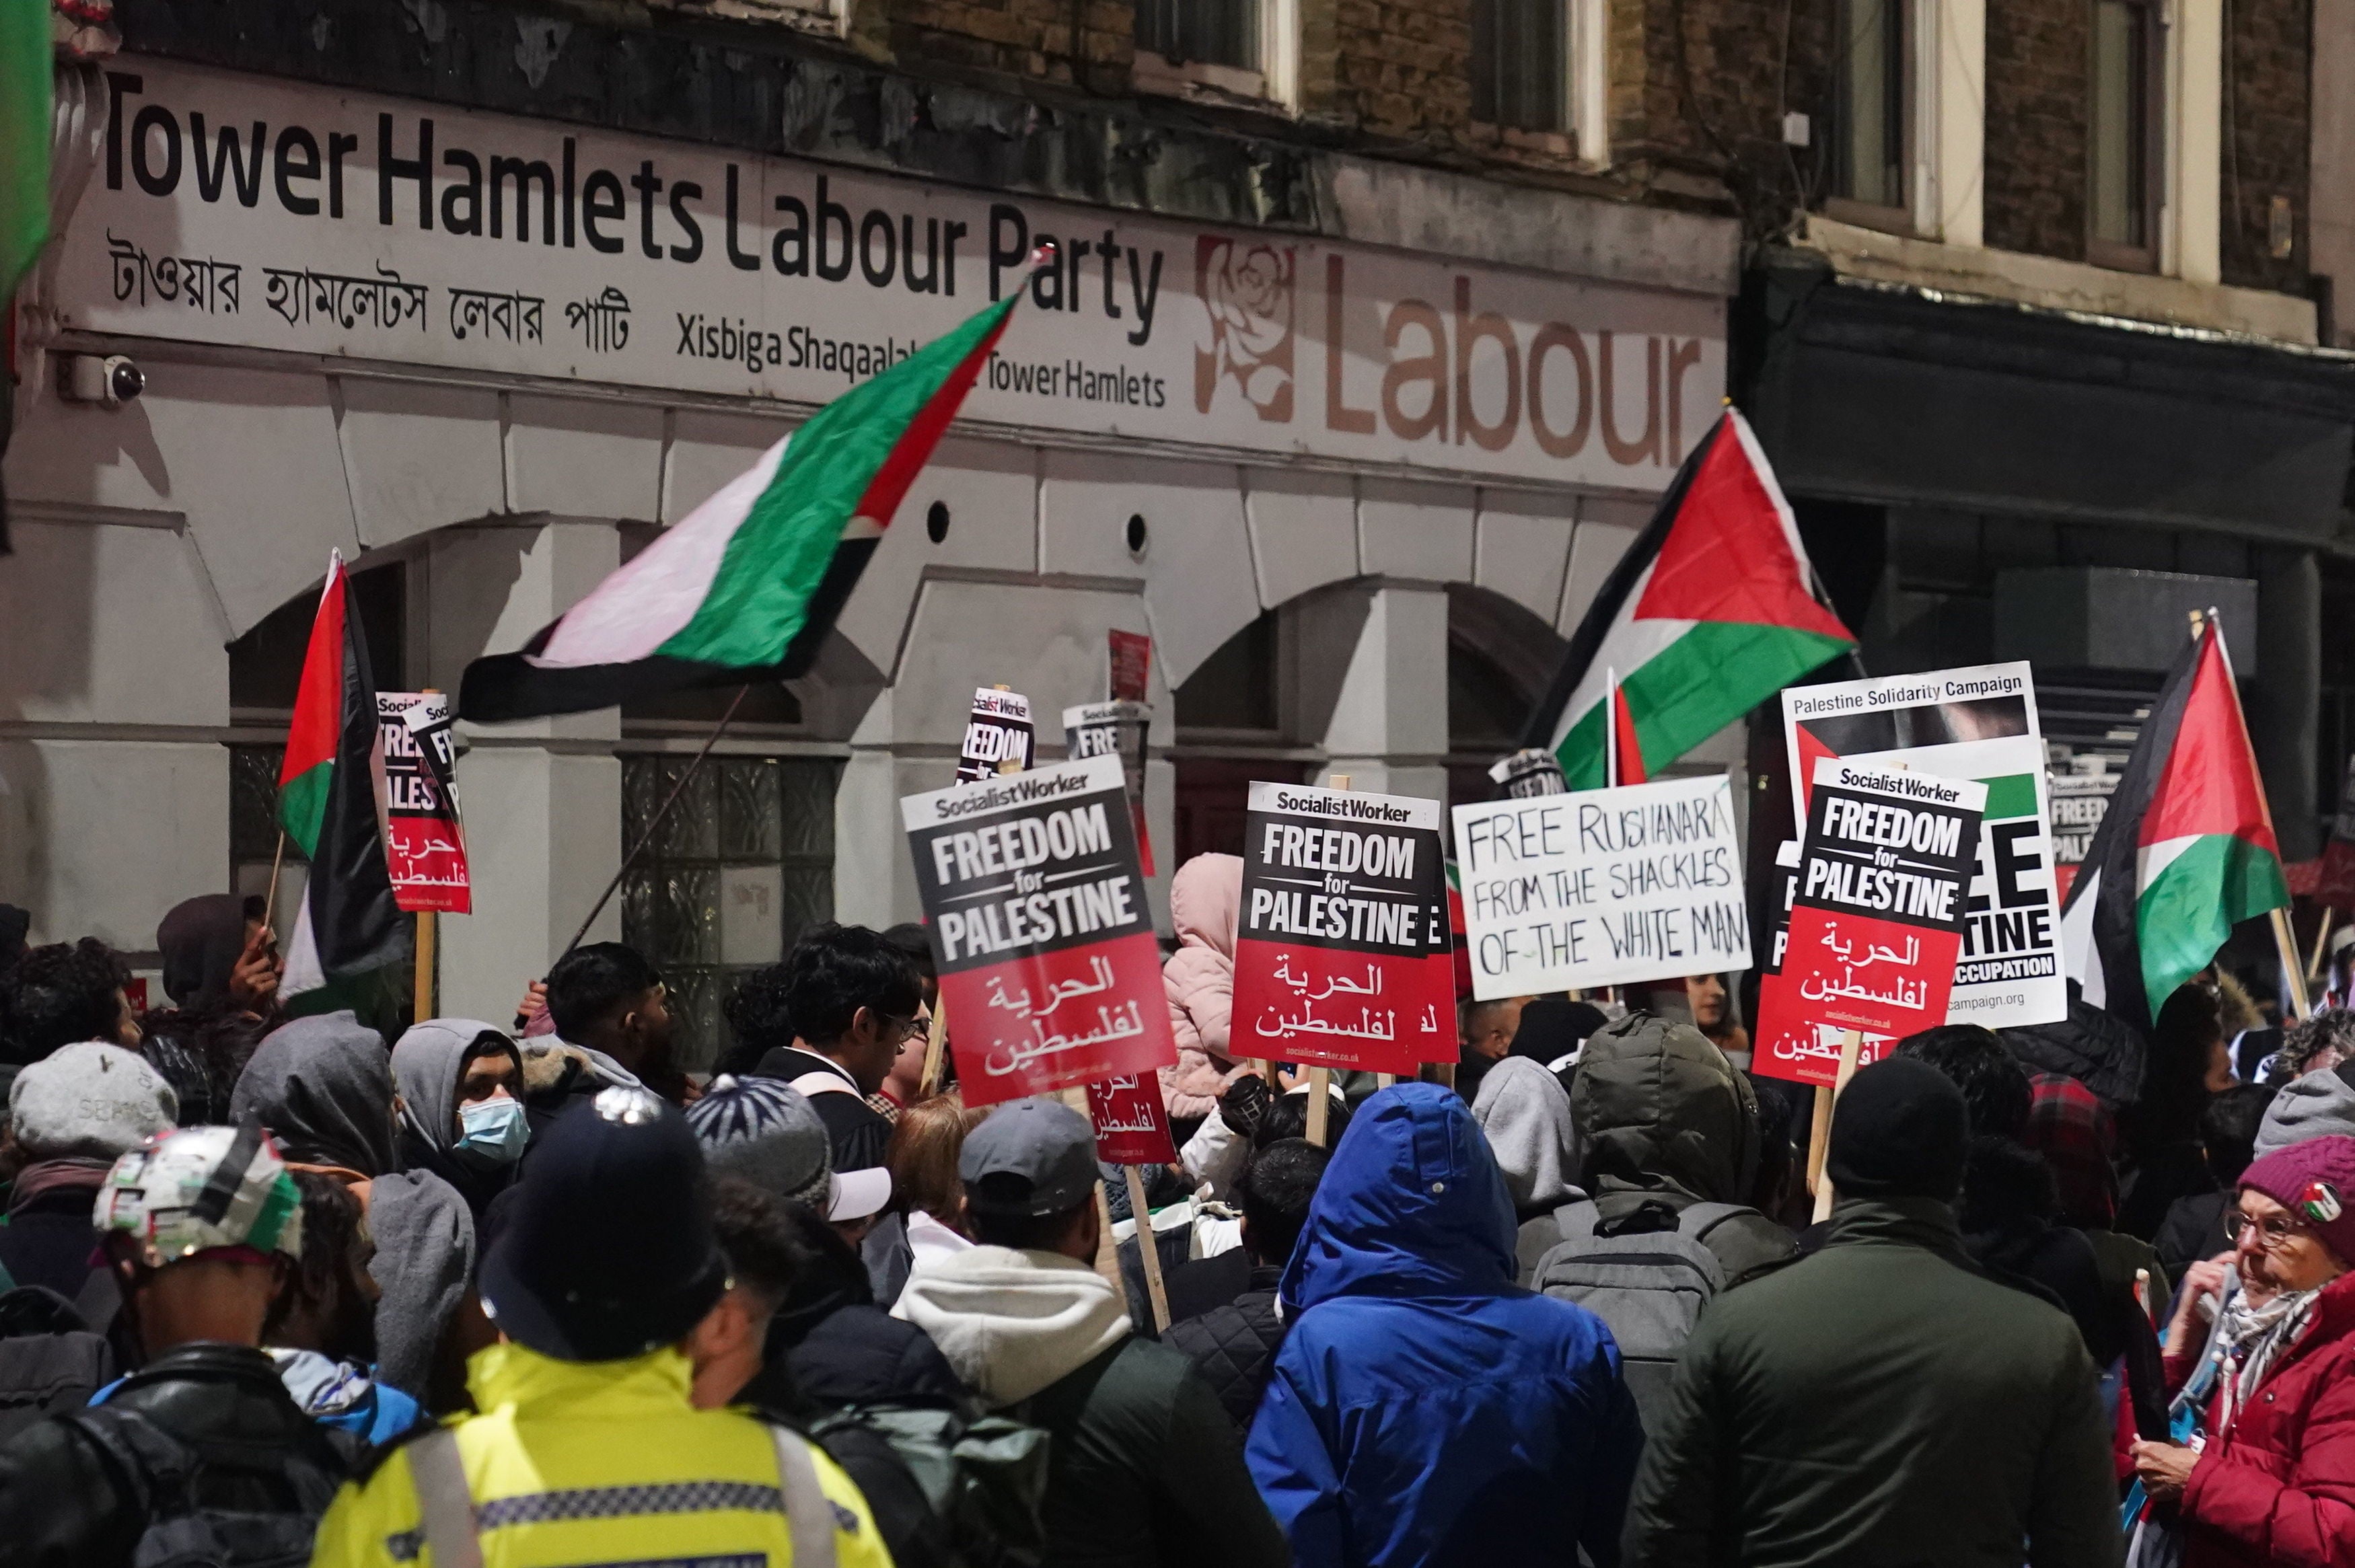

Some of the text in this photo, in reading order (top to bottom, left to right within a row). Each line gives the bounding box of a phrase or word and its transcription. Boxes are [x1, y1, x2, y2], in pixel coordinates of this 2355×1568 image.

[106, 72, 1163, 346] Tower Hamlets Labour Party
[449, 287, 544, 346] লেবার
[677, 313, 781, 373] Xisbiga
[988, 350, 1060, 395] Tower
[1066, 361, 1165, 407] Hamlets
[1326, 254, 1701, 469] Labour
[1794, 675, 2022, 714] Palestine Solidarity Campaign
[935, 773, 1089, 819] Socialist Worker
[1276, 792, 1411, 823] Socialist Worker
[1840, 768, 1960, 803] Socialist Worker
[931, 803, 1112, 886] FREEDOM
[1262, 823, 1416, 880] FREEDOM
[1467, 794, 1731, 872] FREE RUSHANARA
[1821, 796, 1962, 858] FREEDOM
[1014, 868, 1045, 895] for
[1324, 872, 1350, 895] for
[1474, 874, 1547, 922] FROM
[1548, 868, 1597, 908] THE
[1610, 848, 1731, 899] SHACKLES
[1874, 846, 1899, 868] for
[937, 876, 1138, 962] PALESTINE
[1249, 888, 1419, 947] PALESTINE
[1805, 857, 1960, 923] PALESTINE
[1480, 929, 1518, 976] OF
[1529, 920, 1589, 970] THE
[1601, 906, 1683, 962] WHITE
[1692, 900, 1746, 959] MAN
[1820, 920, 1920, 967] الحرية
[985, 955, 1115, 1018] الحرية
[1273, 953, 1382, 1000] الحرية
[1800, 966, 1928, 1010] لفلسطين
[984, 1000, 1145, 1076] لفلسطين
[1256, 1000, 1395, 1041] لفلسطين
